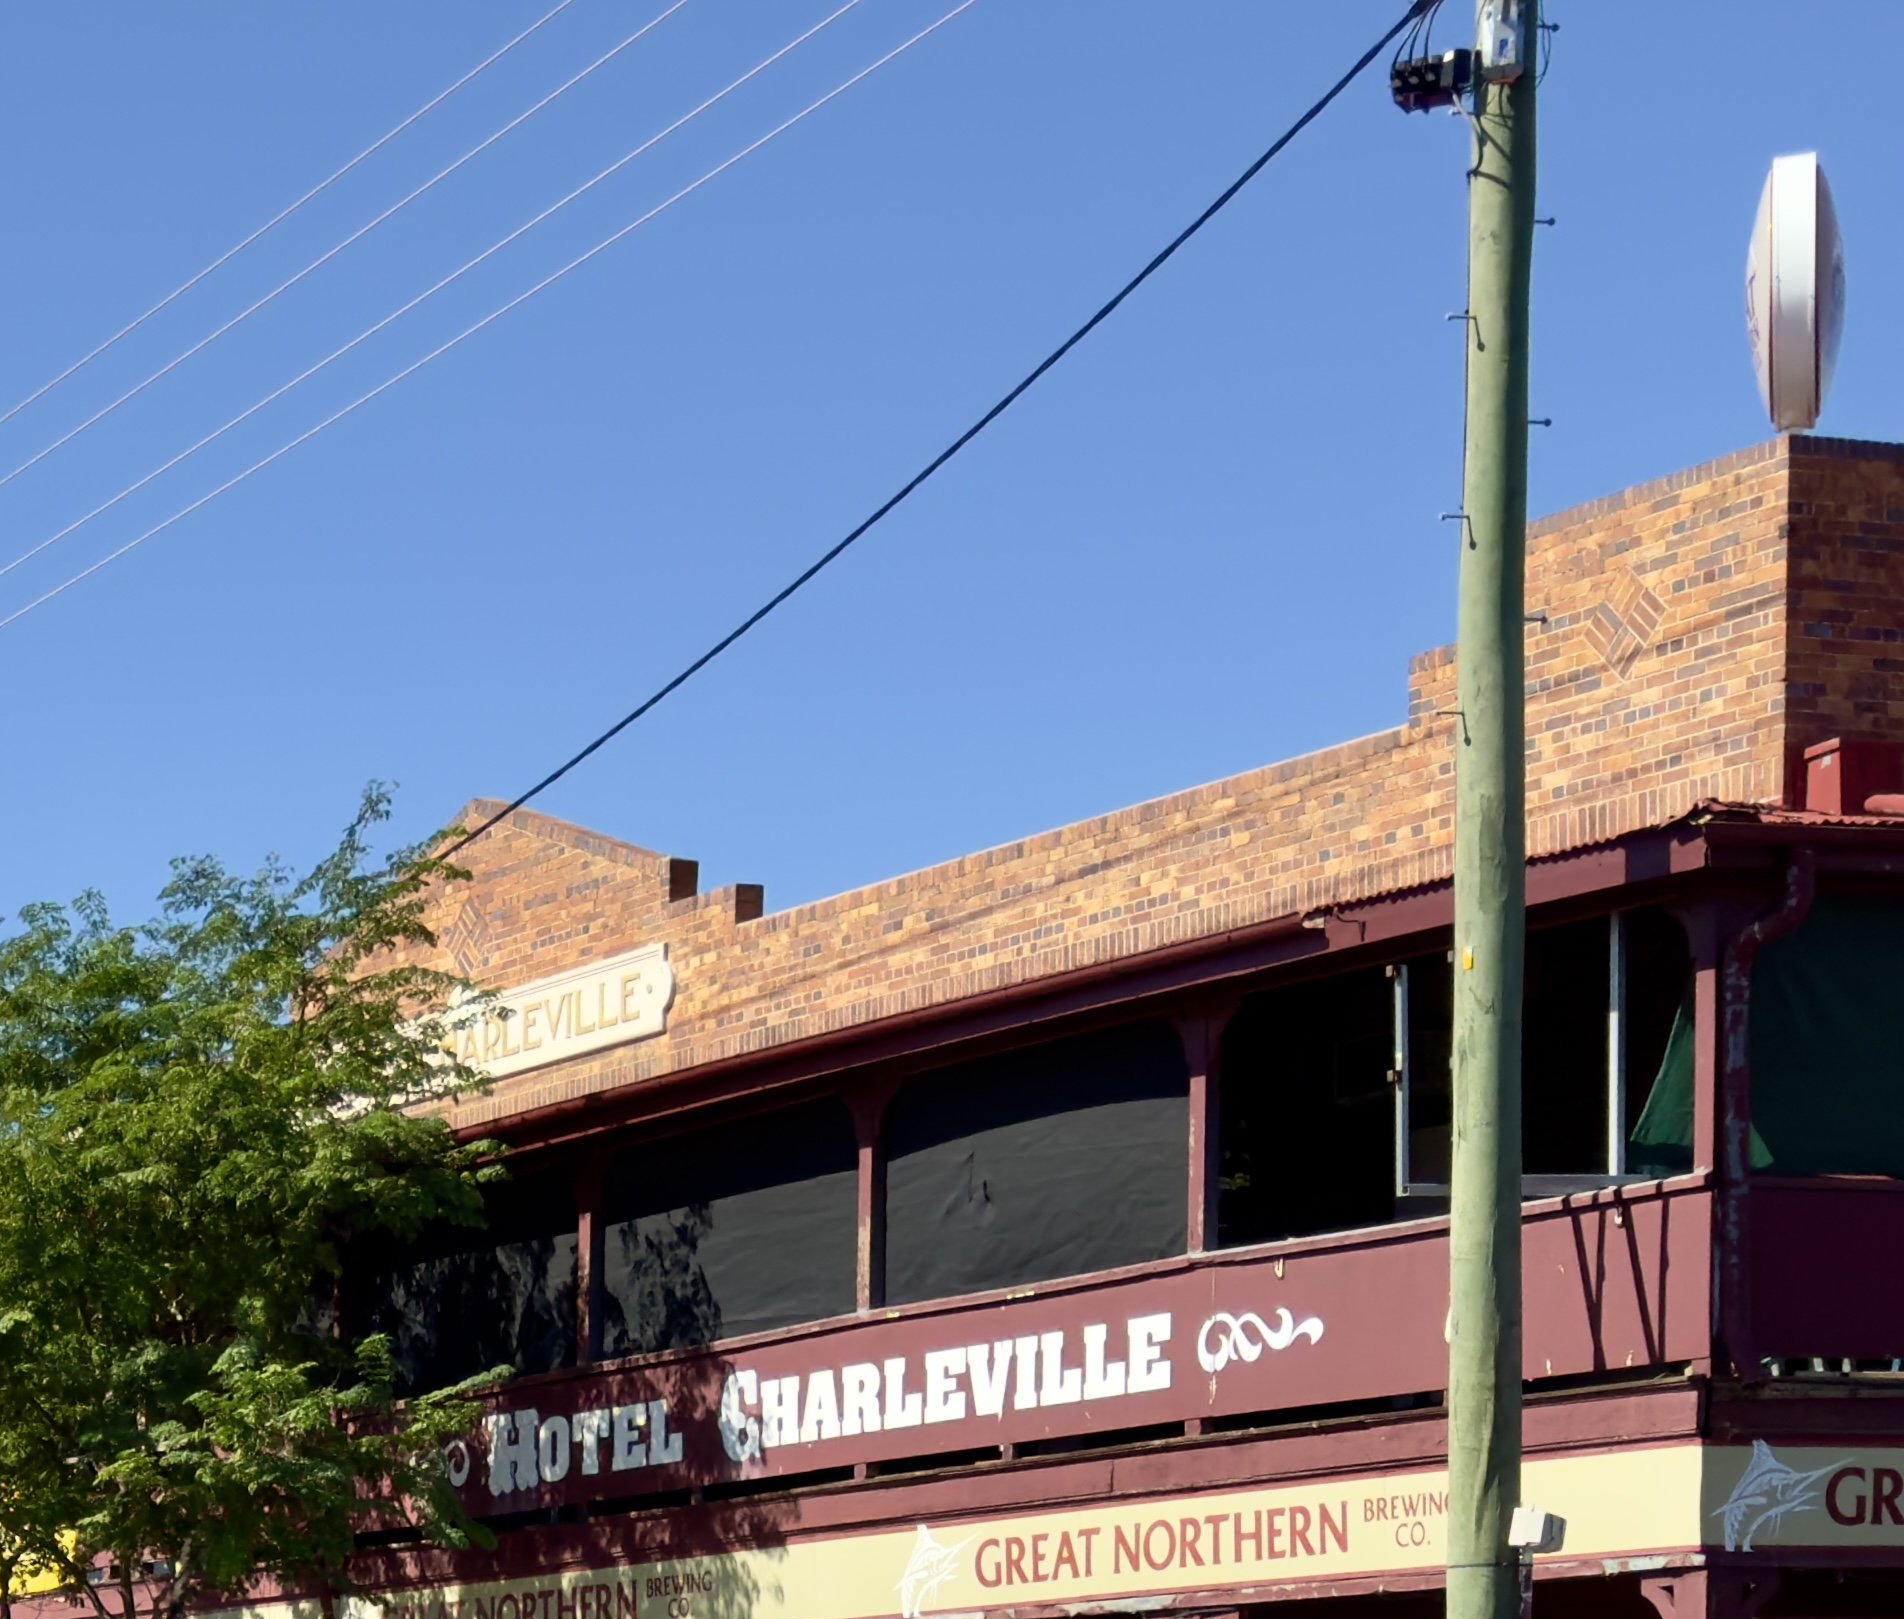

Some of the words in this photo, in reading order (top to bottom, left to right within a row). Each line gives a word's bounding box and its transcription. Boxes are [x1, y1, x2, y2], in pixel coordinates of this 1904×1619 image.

[440, 972, 641, 1067] ARLEVILLE
[483, 1397, 684, 1497] HOTEL
[718, 1311, 1173, 1464] CHARLEVILLE
[975, 1527, 1100, 1588] GREAT
[1113, 1501, 1349, 1574] NORTHERN
[1395, 1521, 1431, 1549] CO.
[645, 1571, 713, 1598] BREWING
[668, 1597, 689, 1619] CO
